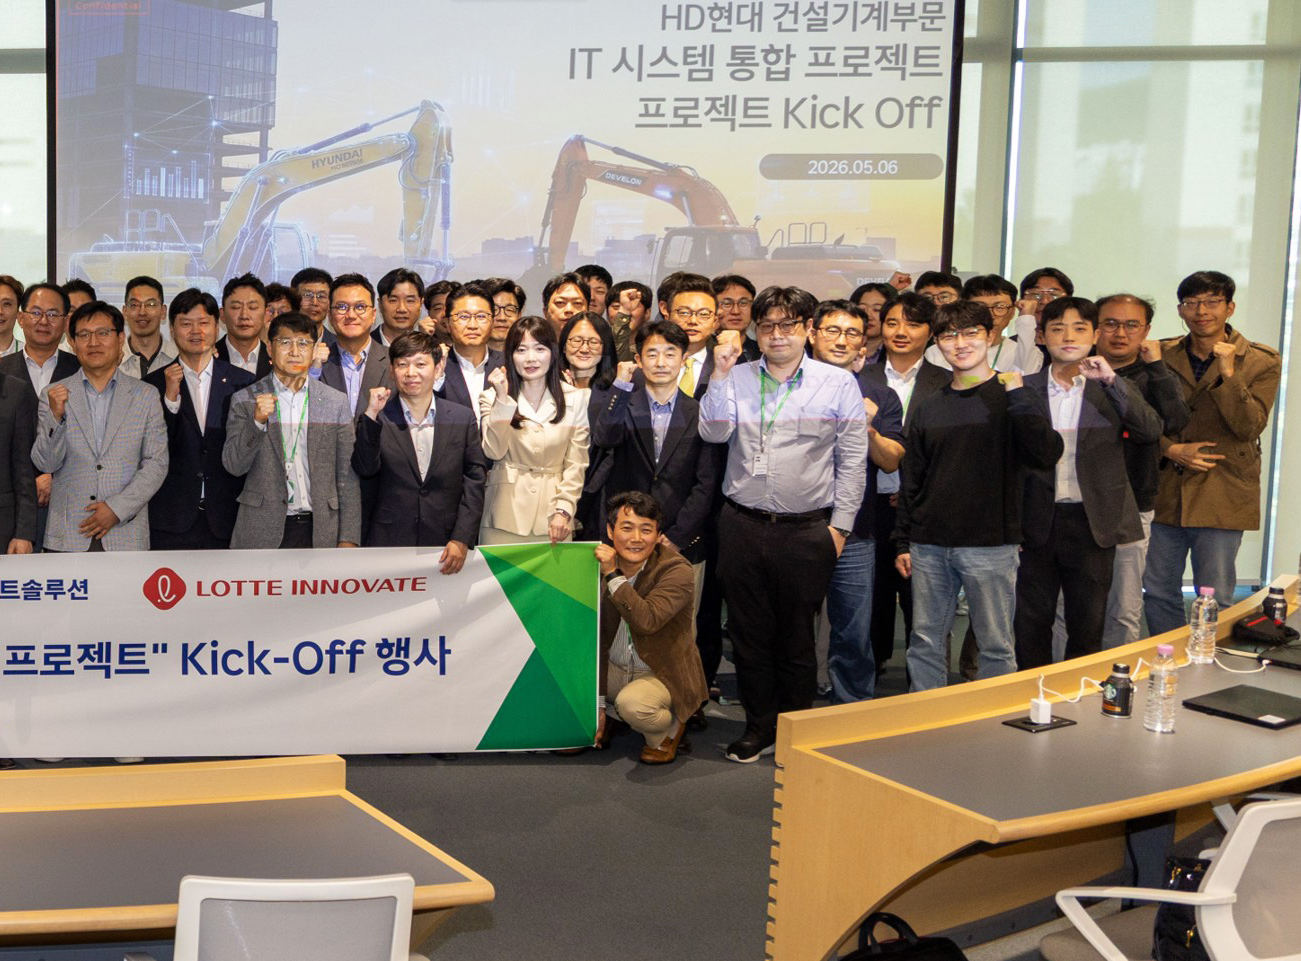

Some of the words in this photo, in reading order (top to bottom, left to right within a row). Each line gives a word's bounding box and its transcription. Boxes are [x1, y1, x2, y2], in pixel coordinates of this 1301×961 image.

[662, 1, 763, 32] HD현대
[774, 1, 946, 32] 건설기계부문
[570, 48, 602, 79] IT
[612, 44, 714, 82] 시스템
[726, 44, 796, 81] 통합
[805, 43, 943, 81] 프로젝트
[635, 95, 772, 132] 프로젝트
[784, 95, 864, 129] Kick
[875, 96, 943, 129] Off
[311, 149, 363, 169] HYUNDAI
[808, 160, 897, 174] 2026.05.06
[605, 172, 642, 185] DEVELON
[197, 580, 282, 596] LOTTE
[292, 577, 426, 595] INNOVATE
[182, 639, 366, 676] Kick-Off
[376, 636, 451, 675] 행사
